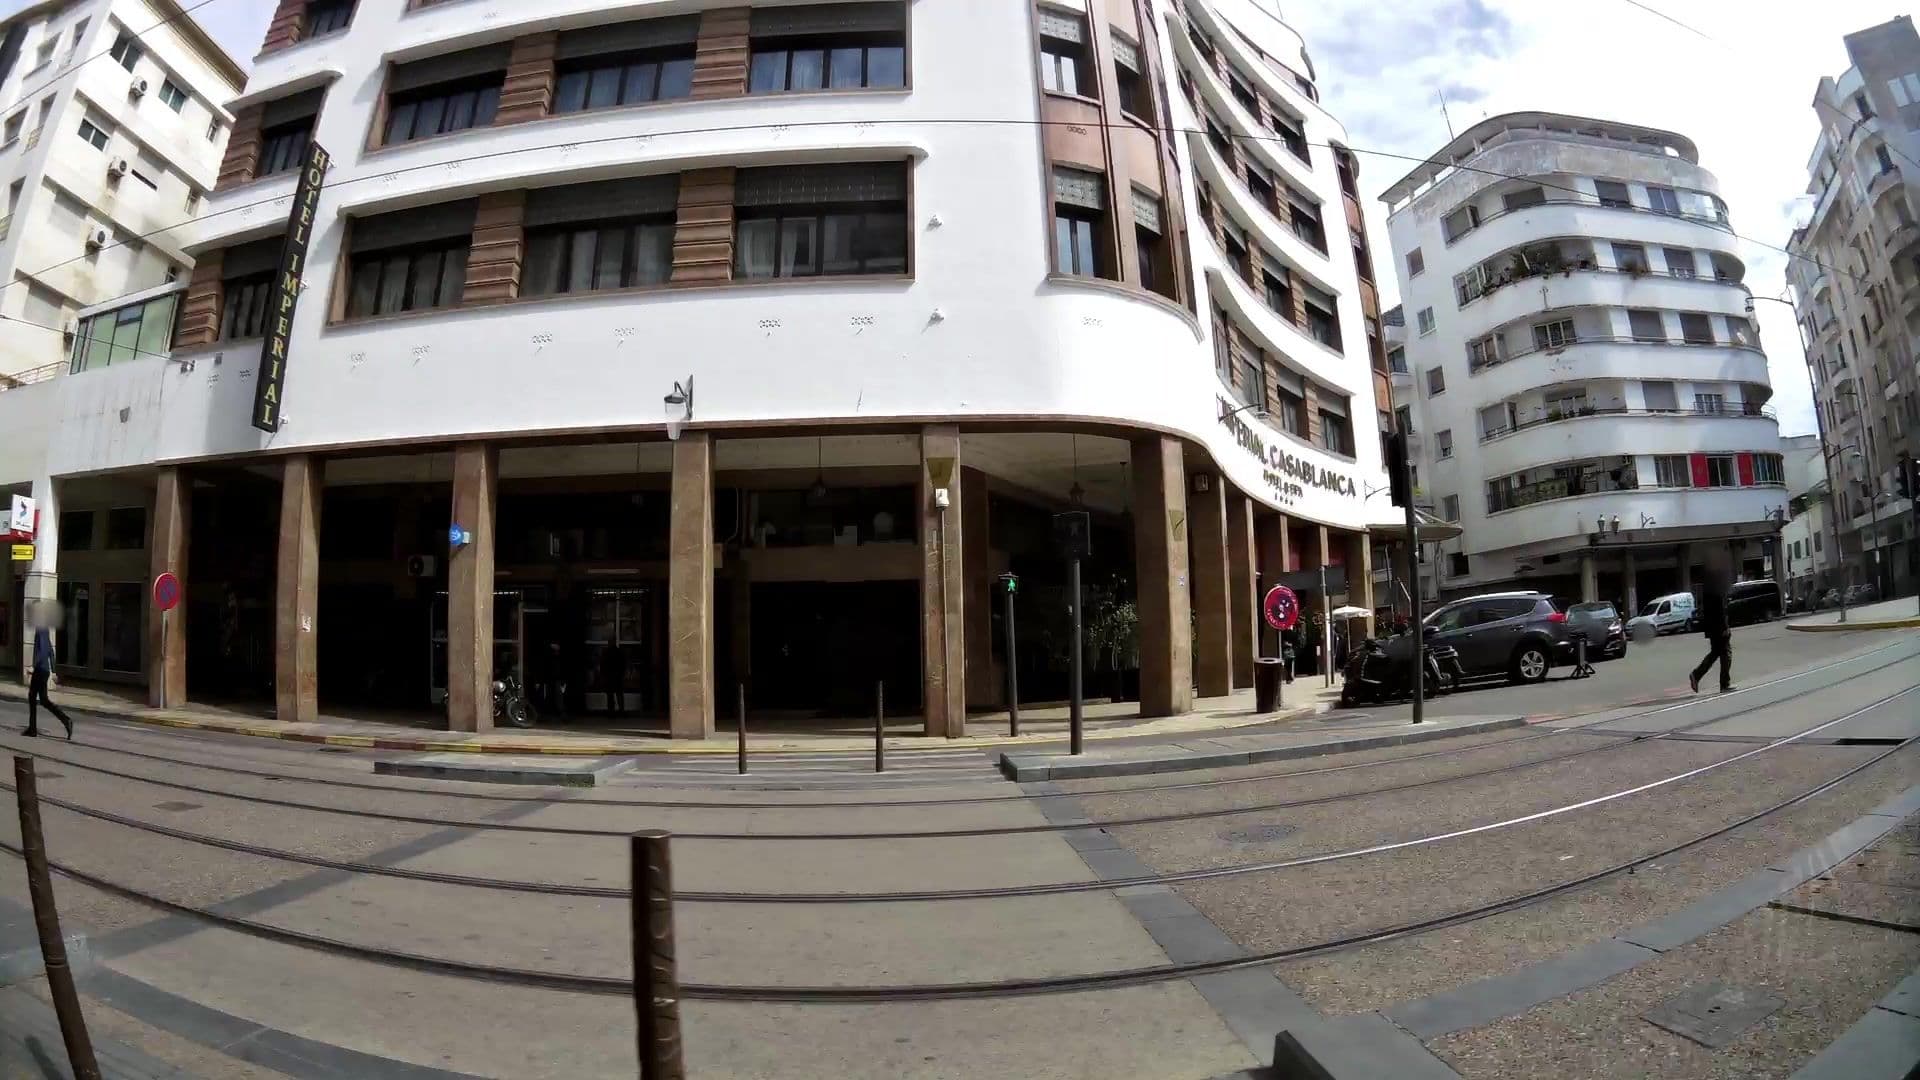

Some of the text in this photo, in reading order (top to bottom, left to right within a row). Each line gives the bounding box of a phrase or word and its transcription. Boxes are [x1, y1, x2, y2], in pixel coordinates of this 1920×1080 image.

[263, 149, 325, 426] HOTEL IMPERIAL
[1269, 445, 1356, 498] CASABLANCA
